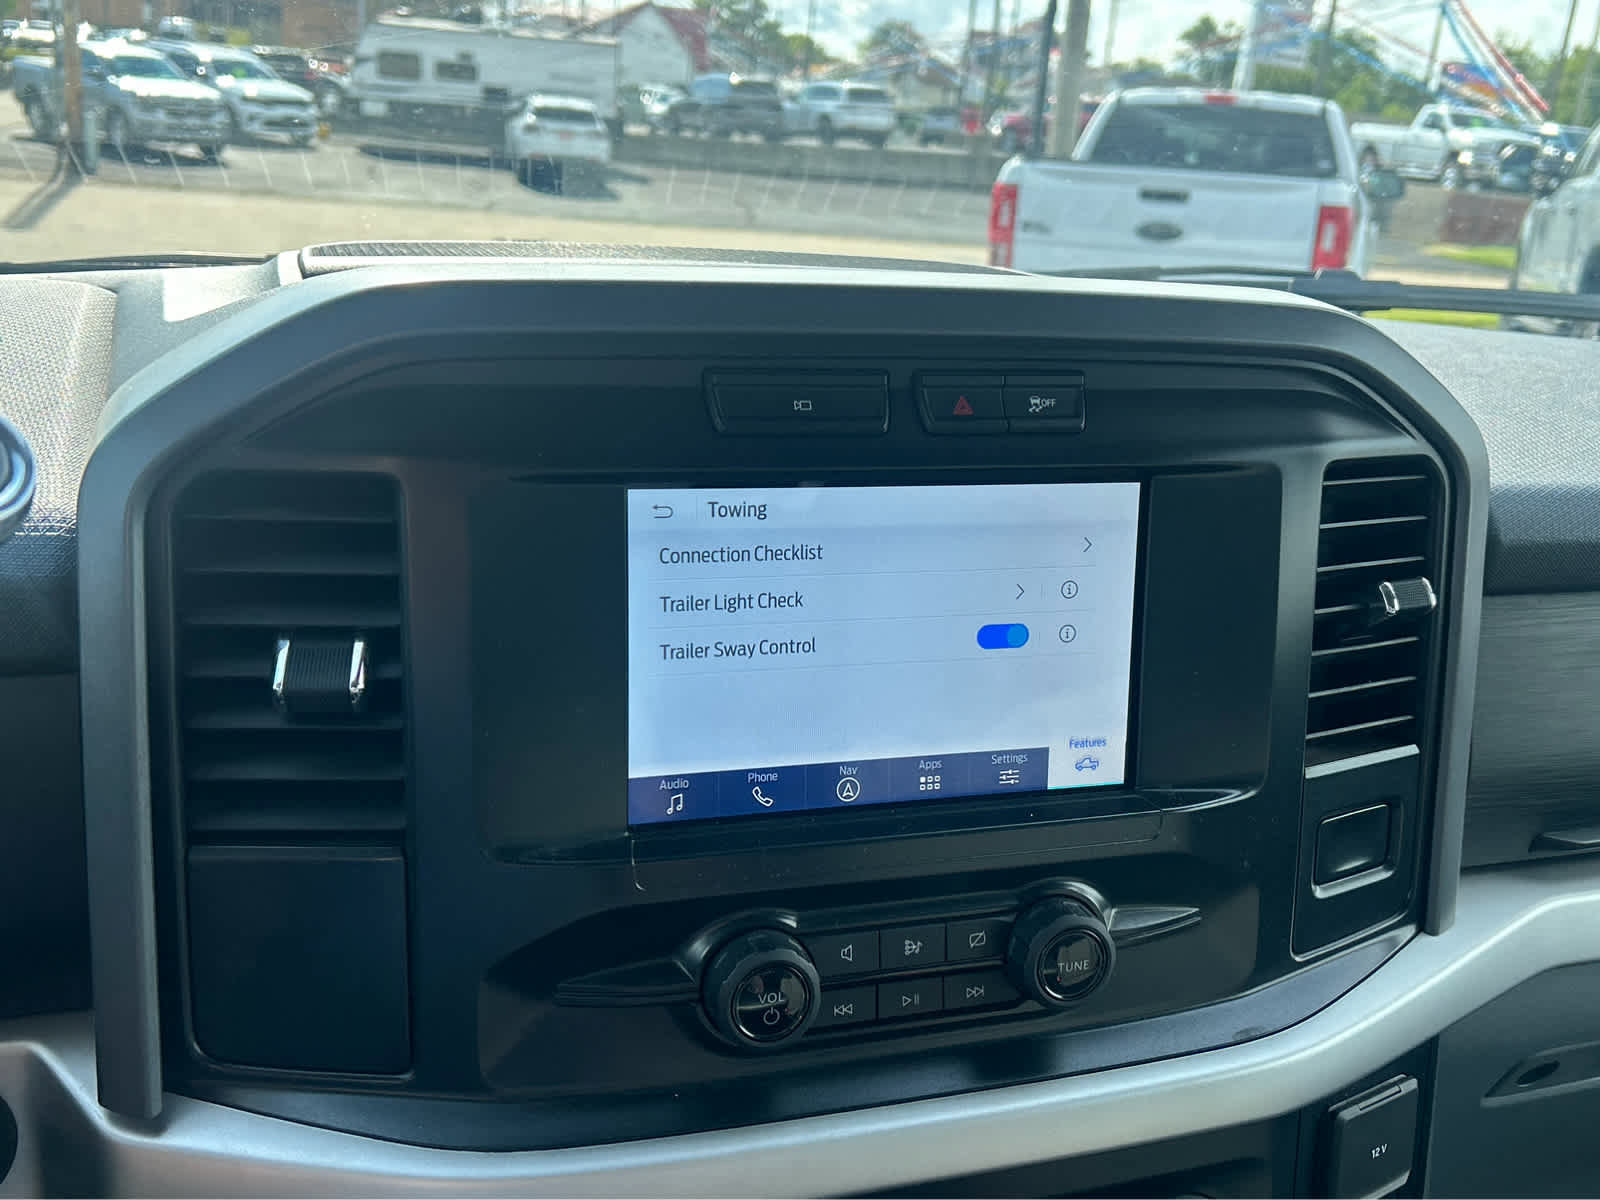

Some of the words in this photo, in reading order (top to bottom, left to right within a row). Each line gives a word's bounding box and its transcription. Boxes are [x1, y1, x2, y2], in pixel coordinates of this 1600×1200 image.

[1041, 398, 1056, 408] OFF
[707, 501, 768, 520] Towing
[659, 546, 751, 564] Connection
[754, 544, 824, 562] Checklist
[660, 595, 711, 613] Trailer
[714, 593, 754, 614] Light
[757, 591, 804, 609] Check
[660, 643, 711, 660] Trailer
[714, 640, 756, 660] Sway
[759, 637, 817, 656] Control
[1069, 738, 1106, 749] Features
[919, 759, 942, 771] Apps
[991, 754, 1028, 765] Settings
[839, 765, 859, 776] Nav
[747, 771, 779, 783] Phone
[659, 779, 689, 790] Audio
[1058, 960, 1089, 973] TUNE
[758, 992, 785, 1005] VOL
[1371, 1147, 1380, 1159] 12
